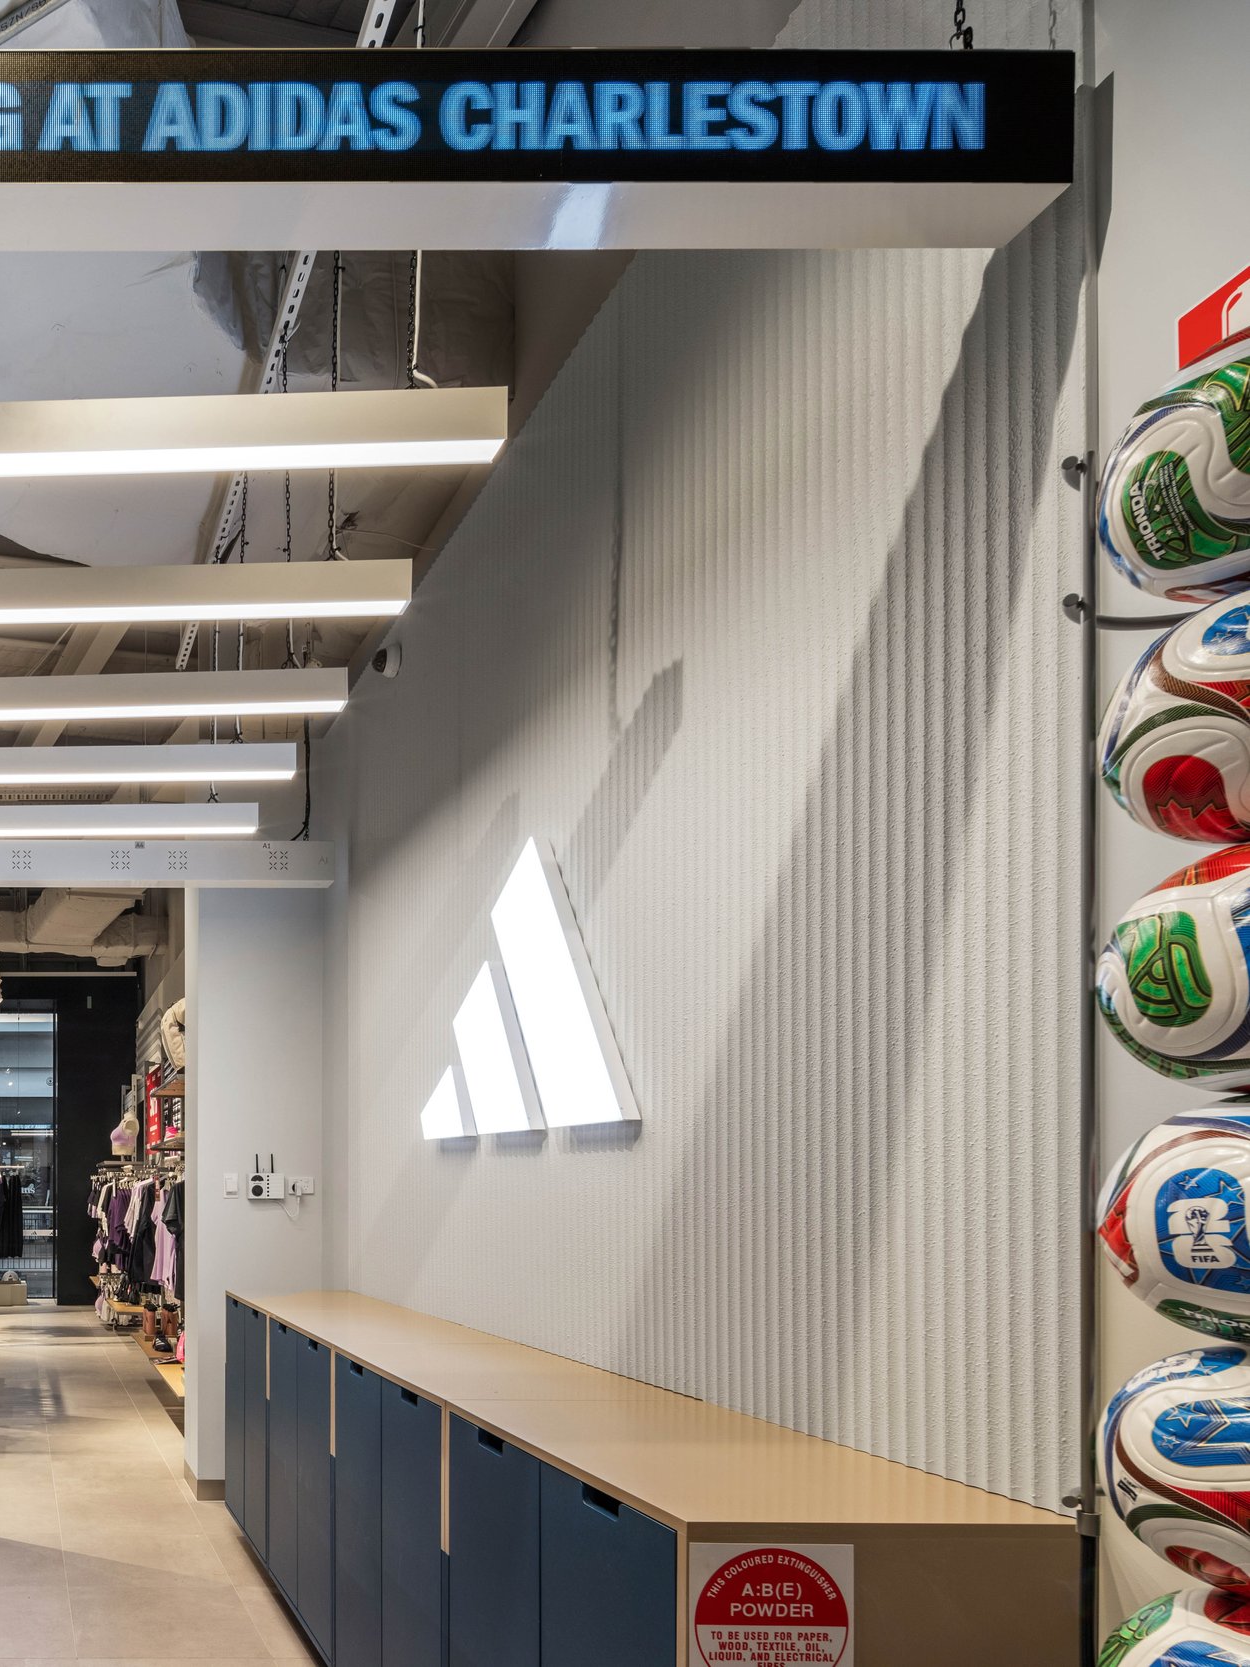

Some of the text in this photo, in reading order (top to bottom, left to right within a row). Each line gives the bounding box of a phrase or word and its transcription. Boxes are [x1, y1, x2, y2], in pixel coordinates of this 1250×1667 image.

[38, 82, 133, 152] AT
[141, 81, 423, 152] ADIDAS
[439, 81, 987, 151] CHARLESTOWN
[1129, 481, 1166, 560] TRIONDA
[1191, 1255, 1221, 1263] FIFA
[707, 1554, 837, 1600] THIS COLOURED EXTINGUISHER
[741, 1582, 803, 1600] A:B(E)
[730, 1602, 815, 1618] POWDER
[711, 1631, 833, 1642] TO BE USED FOR PAPER,
[718, 1641, 825, 1653] WOOD, TEXTILE, OIL,
[708, 1651, 835, 1662] LIQUID, AND ELECTRICAL
